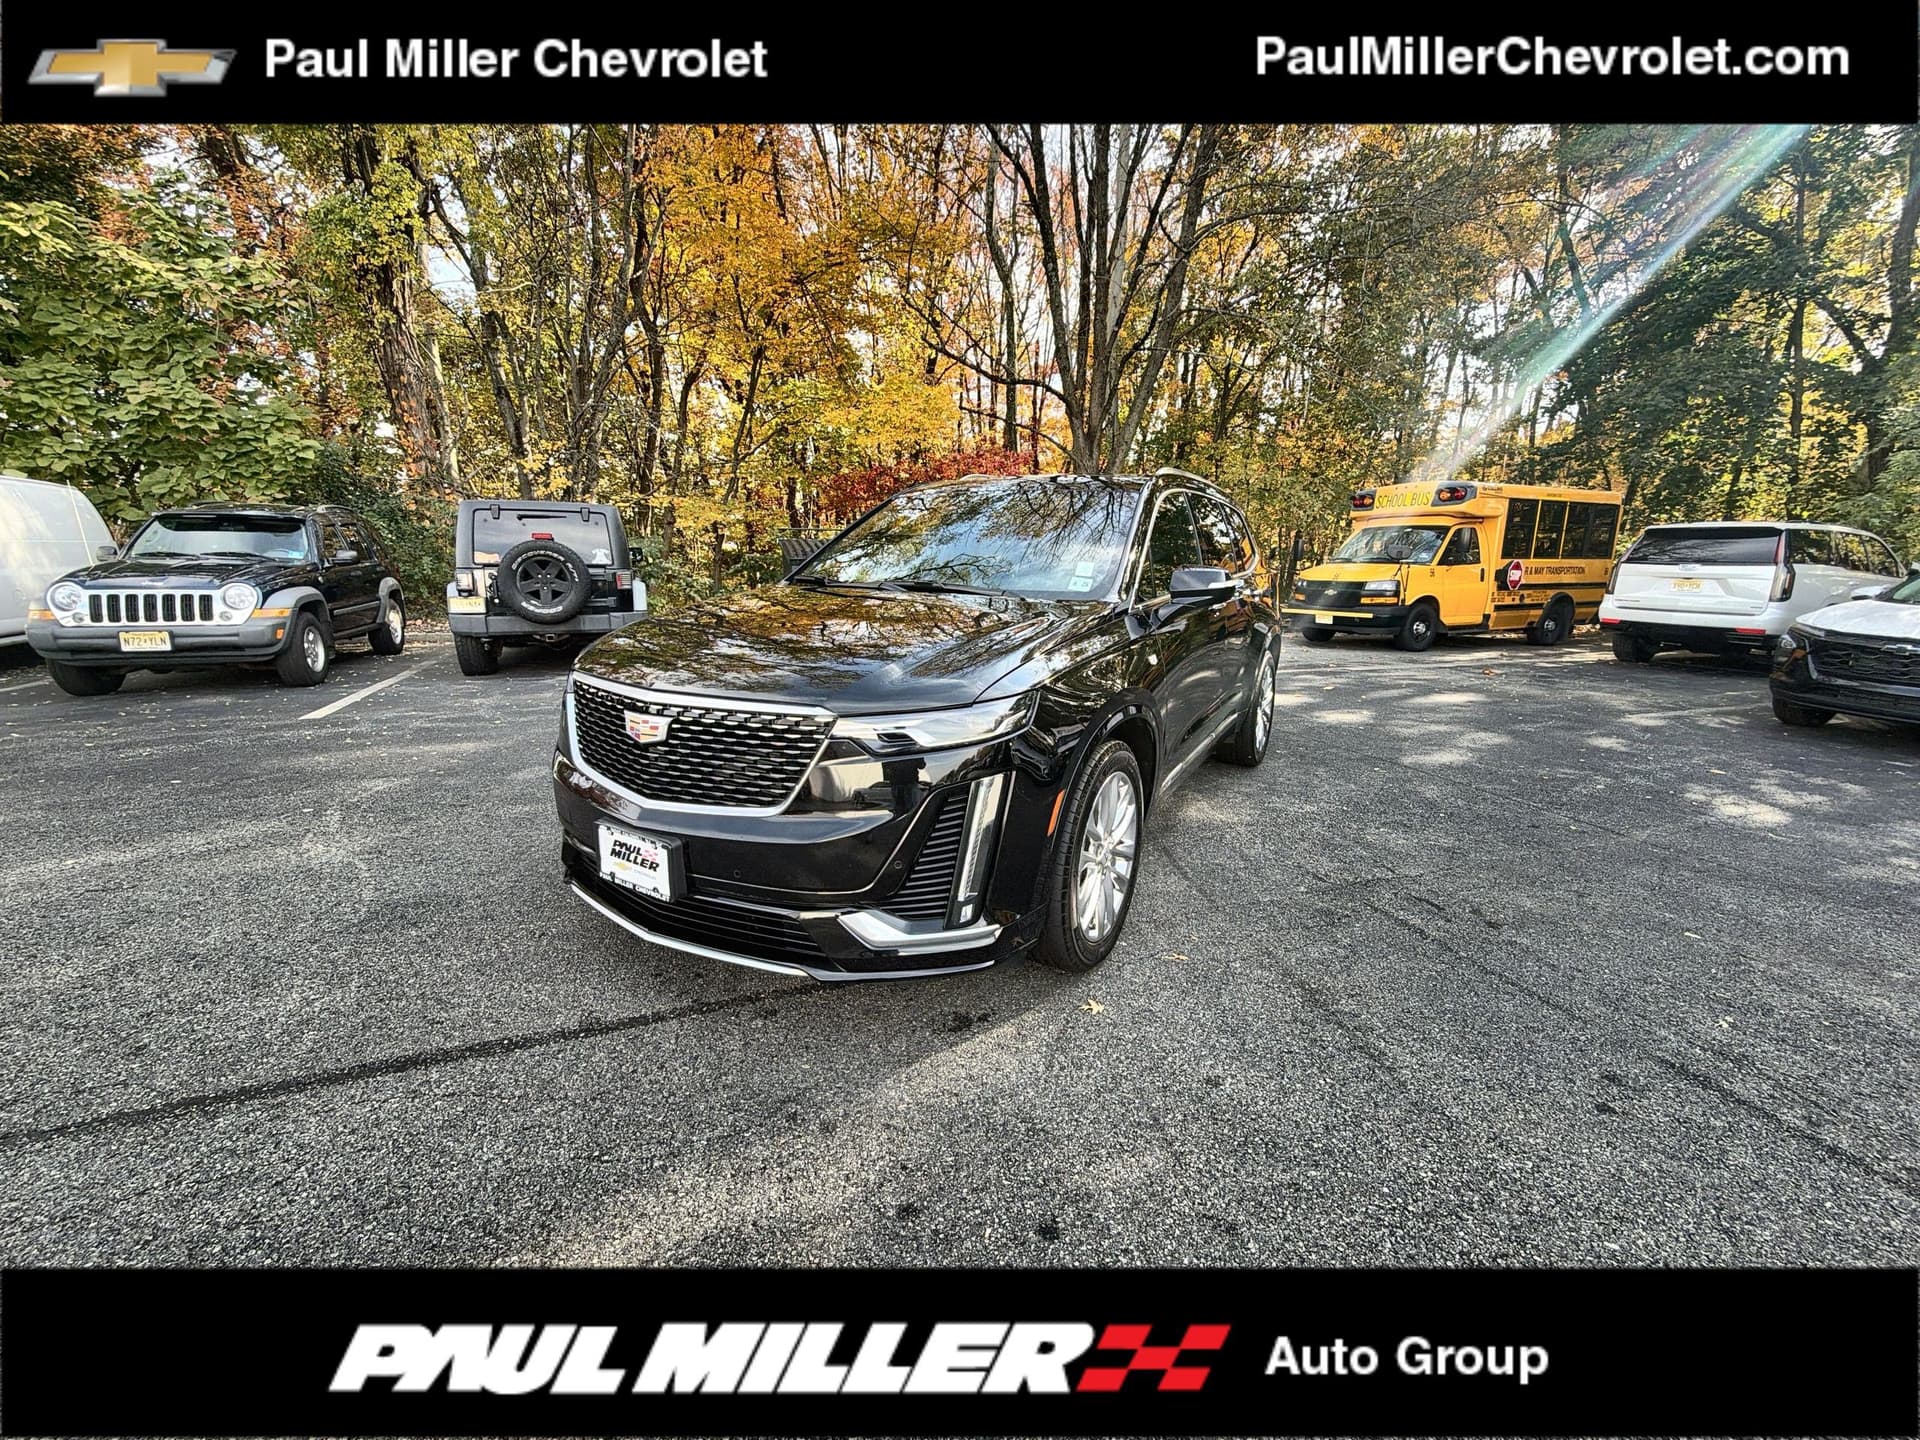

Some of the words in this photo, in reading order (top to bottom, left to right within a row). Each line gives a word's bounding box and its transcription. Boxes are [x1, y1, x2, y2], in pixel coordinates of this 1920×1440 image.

[1376, 490, 1408, 509] SCHOOL
[1410, 490, 1431, 506] BUS
[613, 839, 643, 857] PAUL
[610, 847, 660, 873] MILLER
